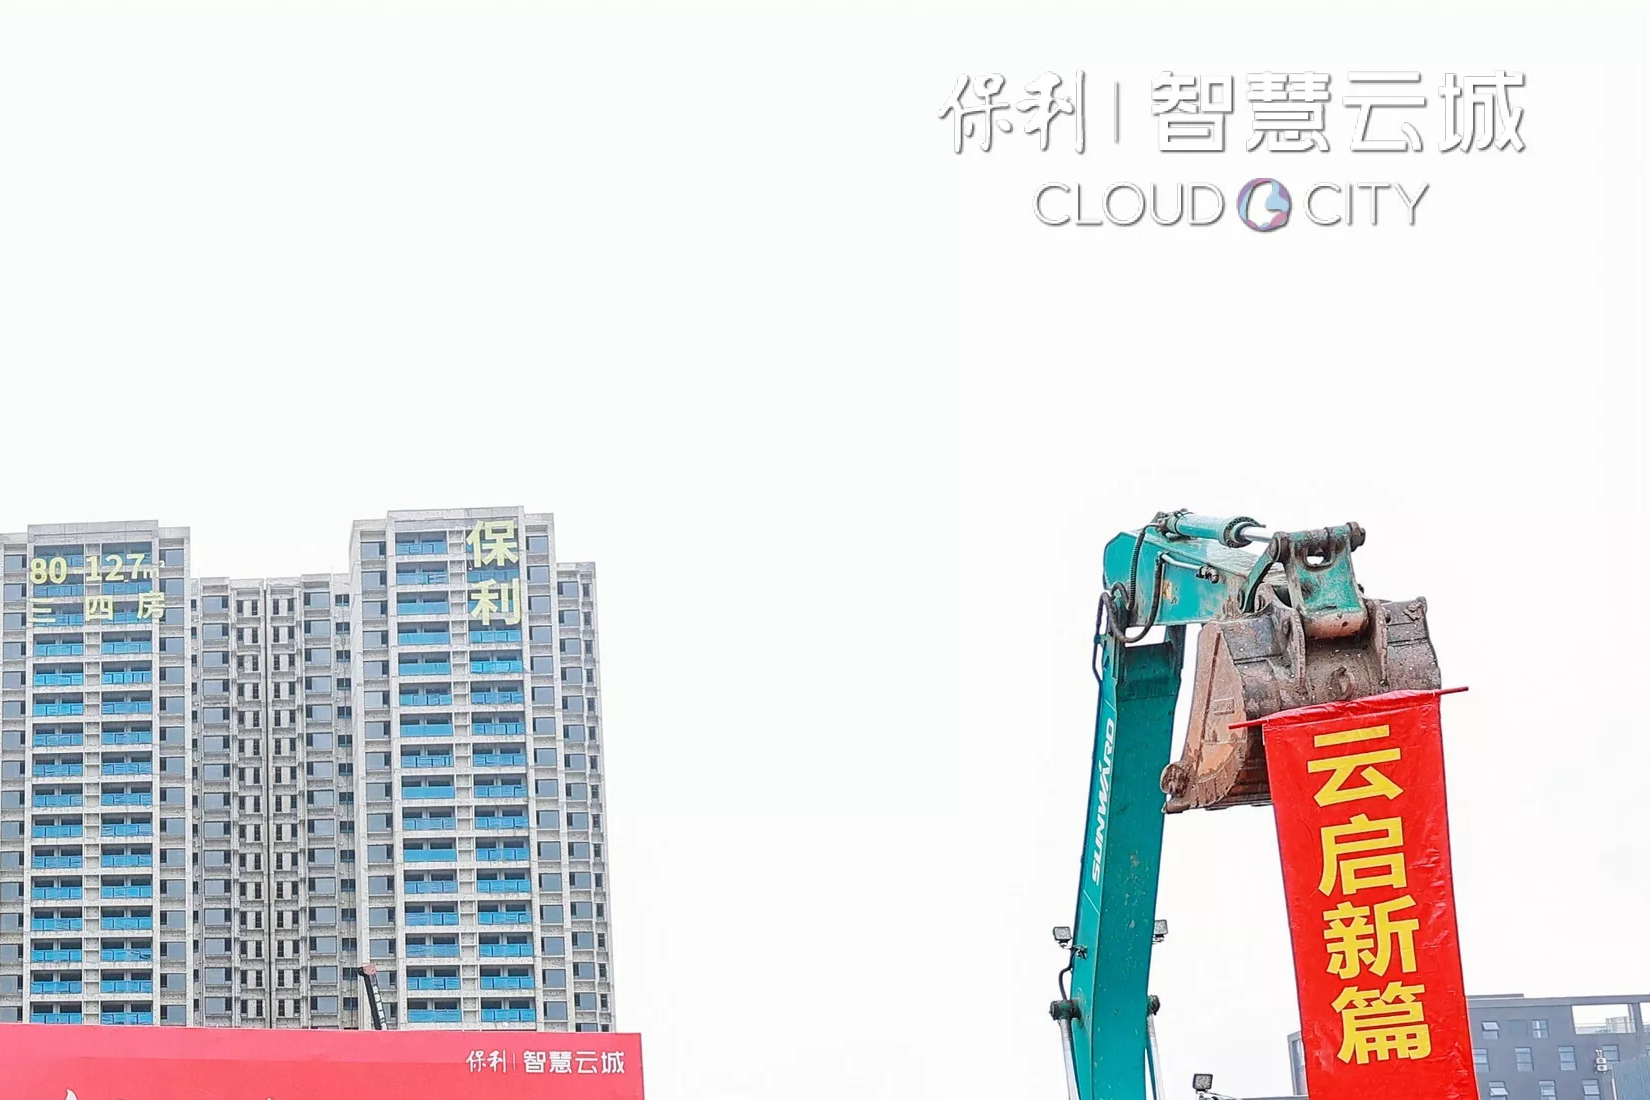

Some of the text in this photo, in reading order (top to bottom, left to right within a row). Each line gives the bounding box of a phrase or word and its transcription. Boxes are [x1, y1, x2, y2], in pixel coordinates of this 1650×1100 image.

[465, 518, 521, 627] 保利
[1091, 717, 1115, 886] SUNWARD
[1306, 723, 1433, 1065] 云启新篇
[466, 1049, 626, 1074] 保利 智慧云城
